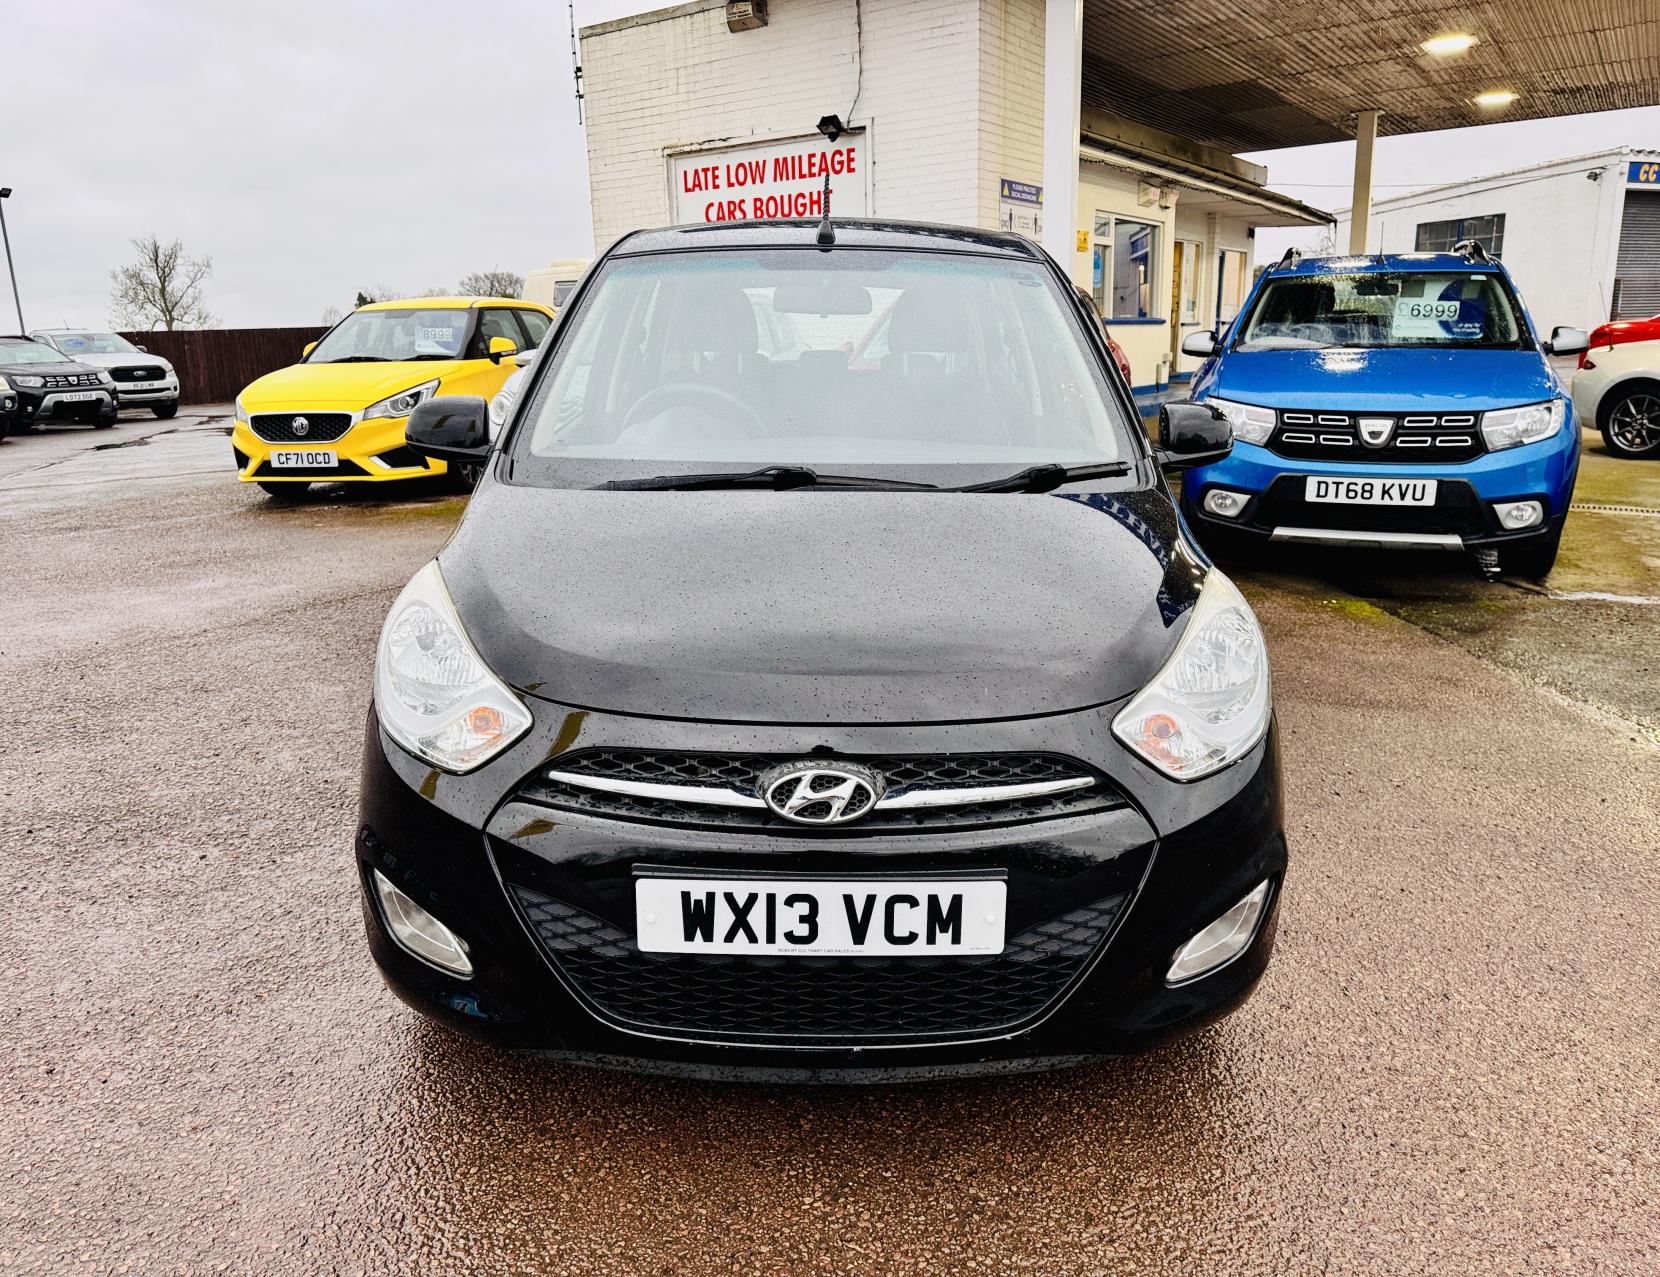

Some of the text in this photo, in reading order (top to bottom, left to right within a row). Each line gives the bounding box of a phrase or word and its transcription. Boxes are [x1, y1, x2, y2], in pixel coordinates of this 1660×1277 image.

[683, 148, 856, 193] LATE LOW MILEAGE
[705, 199, 747, 223] CARS
[423, 329, 452, 340] 8999
[277, 452, 331, 465] CF71 OCD
[1315, 482, 1428, 502] DT68 KVU
[680, 890, 964, 946] WX13 VCM
